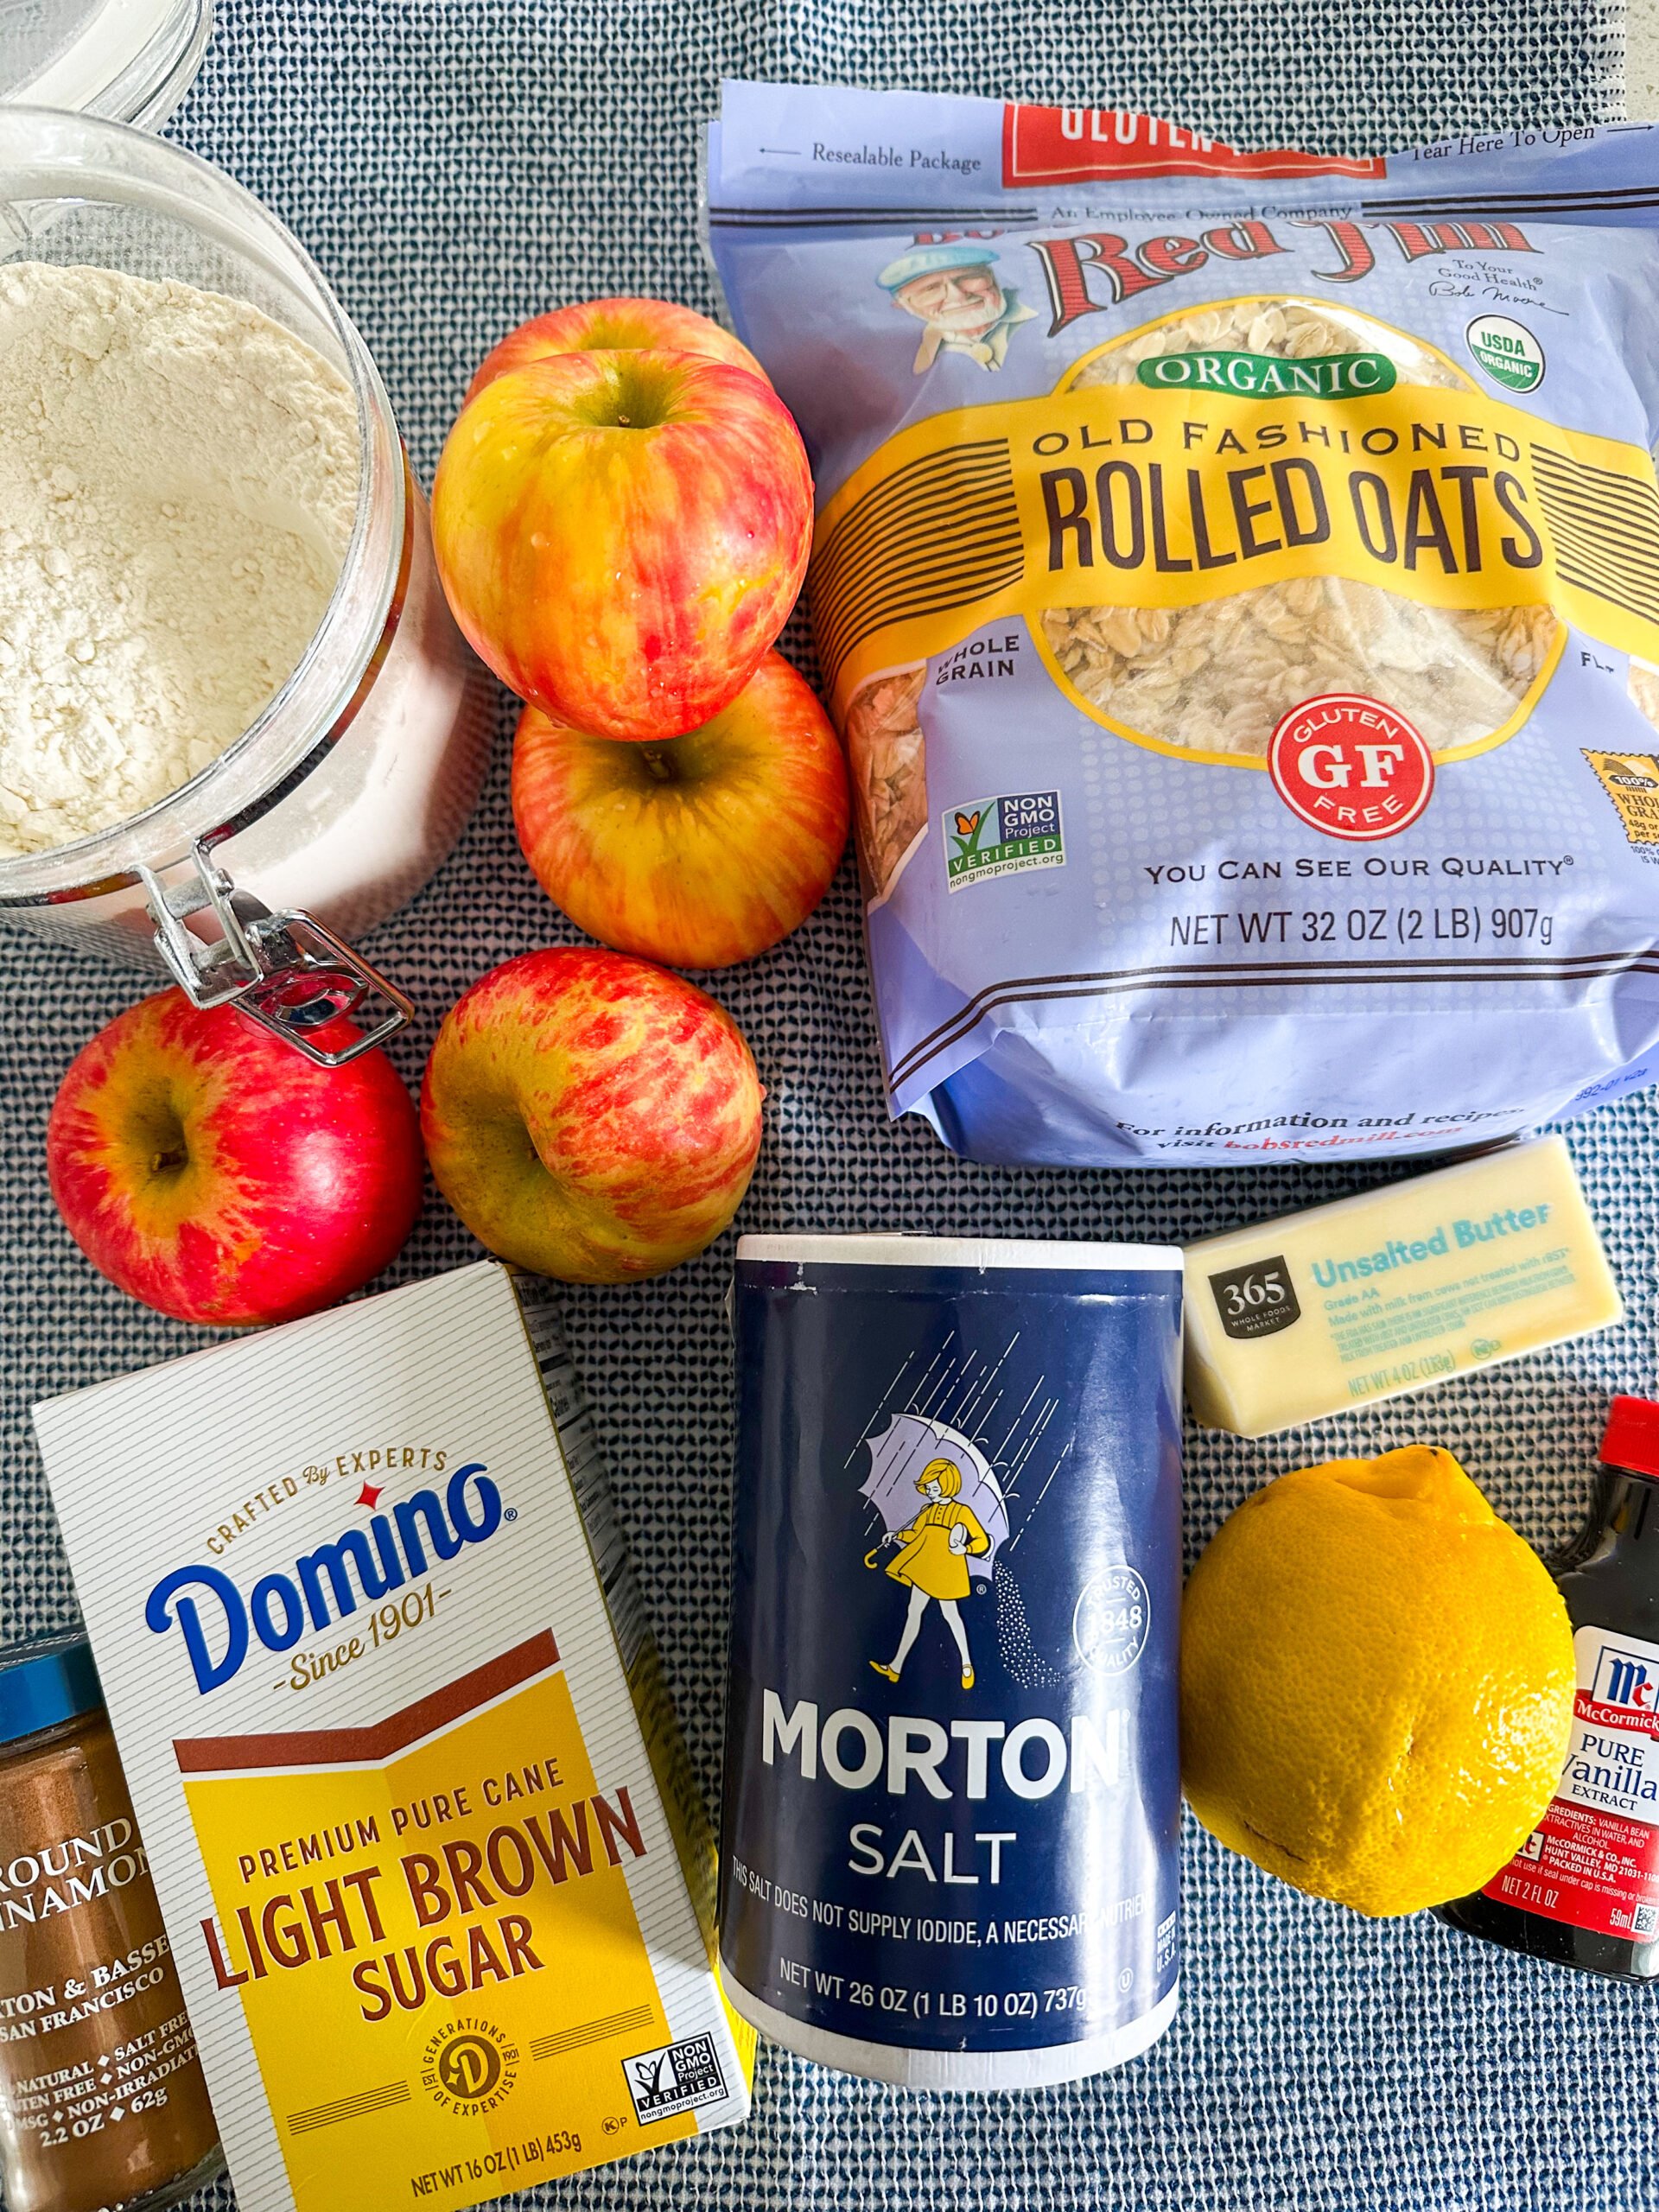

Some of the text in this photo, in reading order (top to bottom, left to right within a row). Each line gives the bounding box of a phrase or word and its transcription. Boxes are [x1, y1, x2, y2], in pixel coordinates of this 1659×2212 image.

[812, 143, 982, 174] Resealable Package
[1458, 138, 1503, 156] Here
[1510, 130, 1535, 147] To
[1051, 206, 1352, 223] An Employee Owned Company
[1027, 221, 1294, 338] Red
[1438, 268, 1480, 282] Good
[1452, 259, 1513, 274] To Your
[1480, 331, 1526, 357] USDA
[1154, 357, 1382, 393] ORGANIC
[1478, 350, 1533, 378] ORGANIC
[1033, 419, 1520, 462] OLD FASHIONED
[1039, 458, 1543, 575] ROLLED OATS
[938, 634, 1020, 676] WHOLE
[936, 659, 1014, 685] GRAIN
[1293, 708, 1400, 743] GLUTEN
[1298, 744, 1404, 789] GF
[1004, 795, 1052, 813] NON
[1004, 808, 1055, 827] GMO
[1313, 794, 1404, 823] FREE
[1005, 822, 1055, 840] Project
[950, 853, 1064, 889] nongmoproject.org
[953, 838, 1057, 872] VERIFIED
[1145, 864, 1206, 885] YOU
[1218, 861, 1281, 880] CAN
[1296, 858, 1351, 878] SEE
[1364, 857, 1429, 876] OUR
[1170, 906, 1554, 946] NET WT 32 OZ (2 LB) 907g
[1116, 1111, 1415, 1136] For information and
[1157, 1139, 1216, 1148] visit
[1311, 1203, 1552, 1288] Unsalted Butter
[1223, 1271, 1286, 1316] 365
[1230, 1305, 1292, 1327] WHOLE FOODS
[1246, 1317, 1281, 1332] MARKET
[1347, 1361, 1421, 1397] NET WT 4 OZ
[206, 1447, 448, 1555] CRAFTED By EXPERTS
[1580, 1732, 1645, 1768] PURE
[1571, 1784, 1637, 1811] EXTRACT
[238, 1758, 564, 1885] PREMIUM PURE CANE
[1592, 1826, 1600, 1835] IN
[1627, 1837, 1645, 1848] AND
[1599, 1821, 1649, 1840] VANILLA BEAN
[848, 1822, 1016, 1885] SALT
[1547, 1835, 1597, 1857] McCORMICK
[1598, 1850, 1605, 1859] &
[1621, 1856, 1637, 1867] INC.
[1573, 1833, 1611, 1850] ALCOHOL.
[1545, 1846, 1618, 1872] HUNT VALLEY, MD
[1548, 1858, 1616, 1883] PACKED IN U.S.A.
[200, 1785, 648, 1993] LIGHT BROWN
[1501, 1874, 1560, 1909] NET 2 FL OZ
[1522, 1862, 1636, 1901] use if seal under cap is missing or
[733, 1855, 1094, 1948] THIS SALT DOES NOT SUPPLY IODIDE, A NECESSAR
[352, 1914, 546, 2023] SUGAR
[41, 1967, 164, 2032] FRANCISCO
[64, 1979, 86, 1999] &
[779, 1957, 1087, 2021] NET WT 26 OZ (1 LB 10 OZ) 737g
[423, 2018, 506, 2064] GENERATIONS
[502, 2049, 520, 2062] 1901
[671, 2040, 708, 2062] NON
[16, 2031, 156, 2094] NATURAL SALT
[675, 2052, 711, 2072] GMO
[677, 2064, 715, 2083] Project
[53, 2078, 97, 2104] FREE
[433, 2070, 517, 2117] OF EXPERTISE
[639, 2087, 725, 2120] nongmoproject.org
[640, 2075, 717, 2108] VERIFIED
[40, 2087, 168, 2147] 2.2 OZ 62g
[410, 2131, 582, 2198] NET WT 16 OZ (1 LB) 453g
